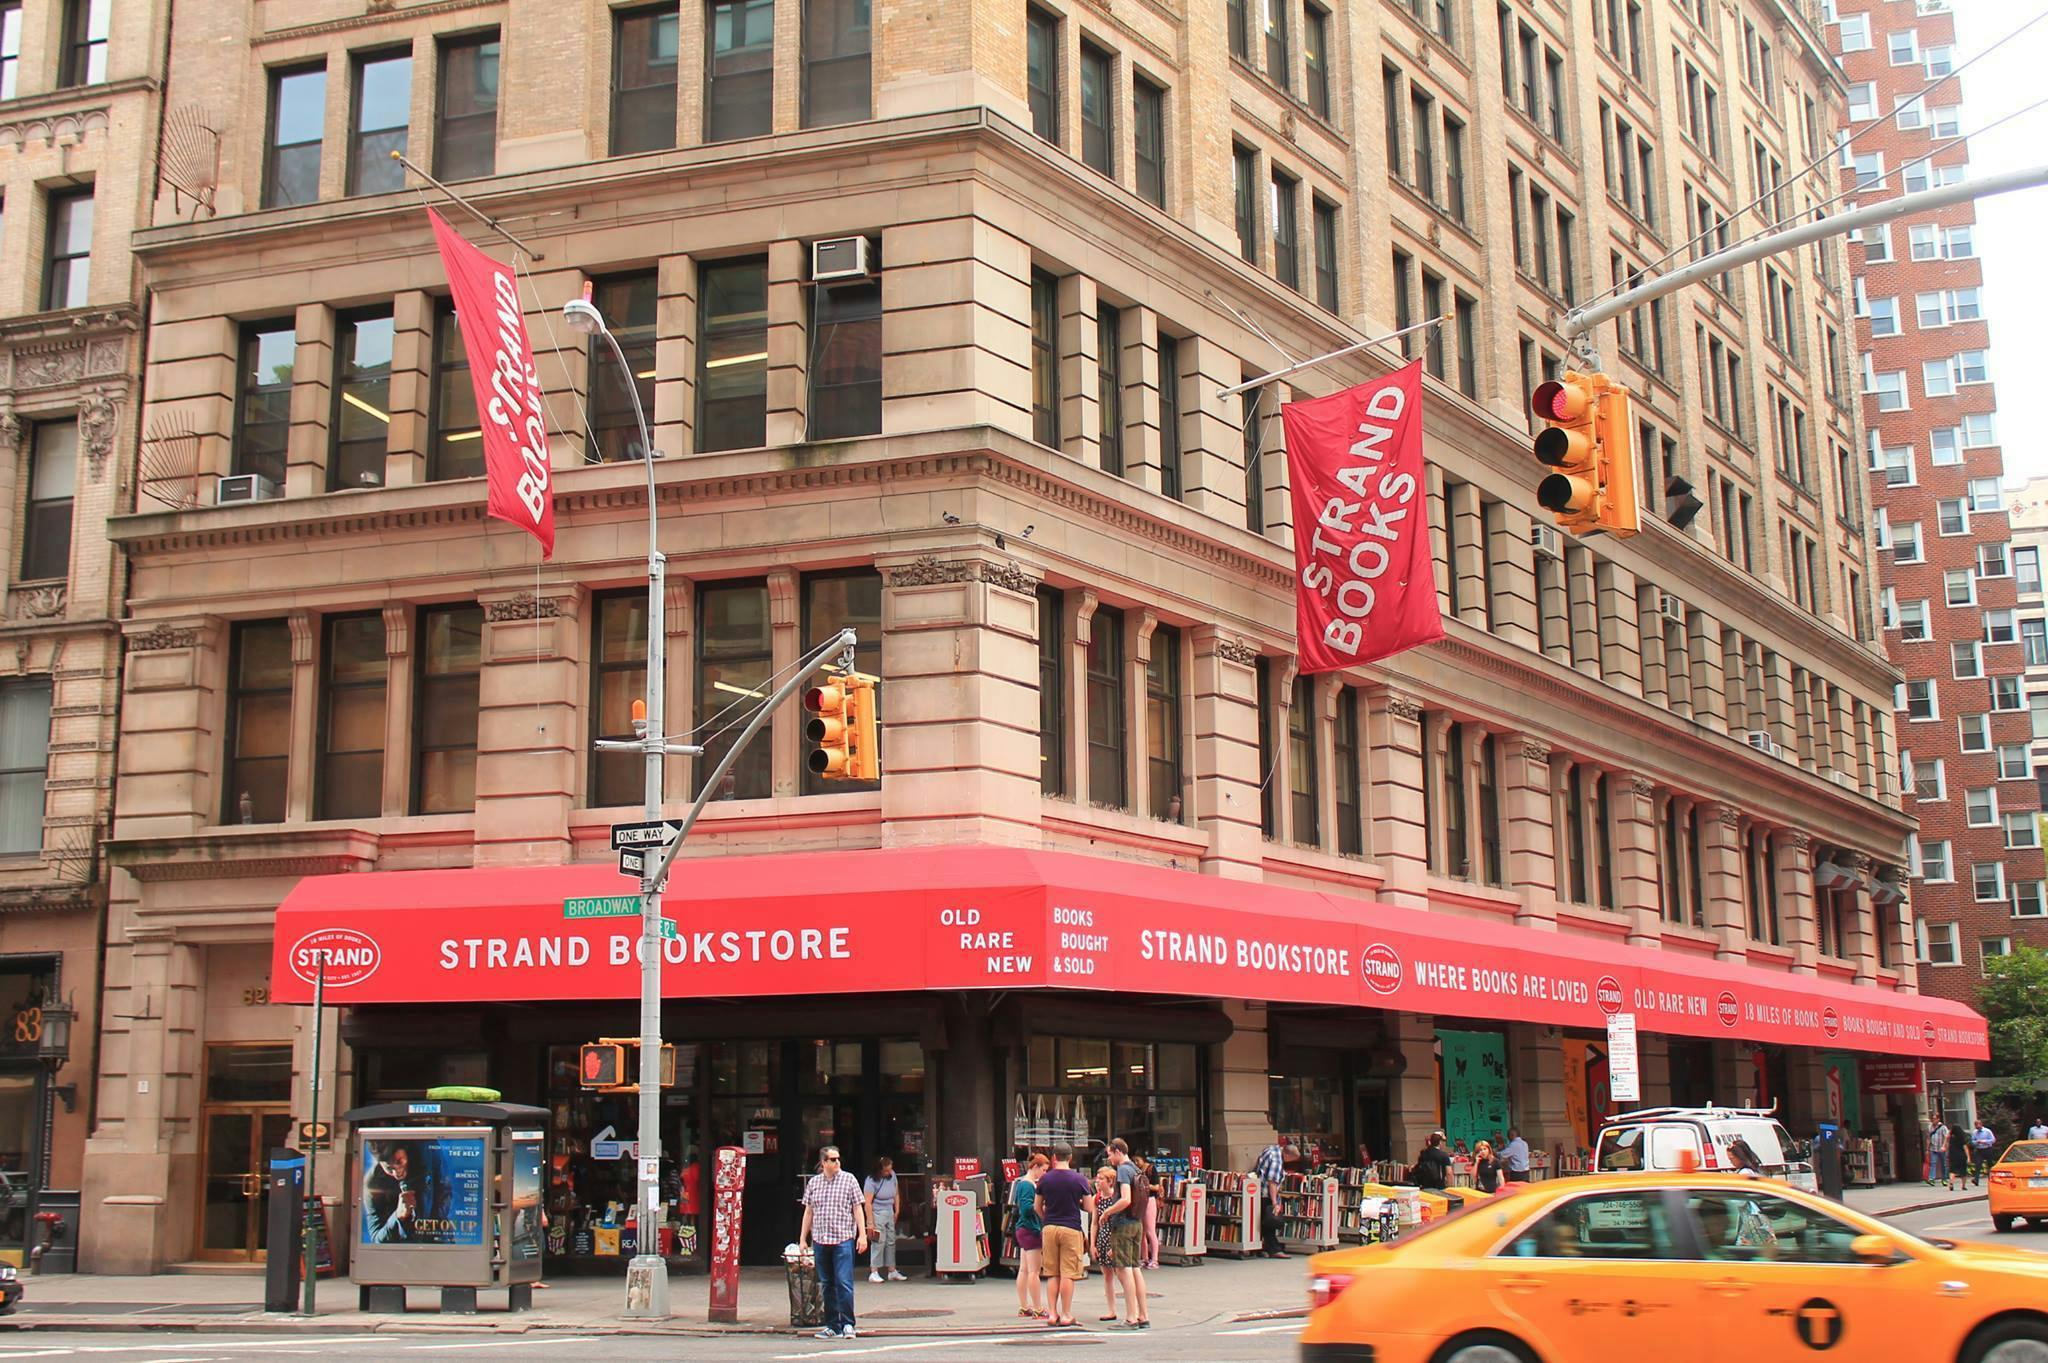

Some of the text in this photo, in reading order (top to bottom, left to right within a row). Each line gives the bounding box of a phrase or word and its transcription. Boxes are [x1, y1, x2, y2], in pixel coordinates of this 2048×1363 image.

[488, 270, 524, 443] STRAND
[1302, 386, 1406, 597] STRAND
[1323, 471, 1416, 656] BOOKS
[618, 828, 664, 842] ONE WAY
[624, 856, 639, 868] ONE
[568, 898, 635, 916] BROADWAY
[940, 908, 981, 926] OLD
[1053, 907, 1094, 927] BOOKS
[960, 932, 1014, 949] RARE
[1061, 932, 1109, 952] BOUGHT
[297, 947, 374, 967] STRAND
[439, 936, 591, 969] STRAND
[1140, 929, 1350, 976] STRAND BOOKSTORE
[987, 956, 1032, 973] NEW
[1053, 956, 1094, 975] & SOLD
[1365, 958, 1400, 979] STRAND
[1414, 960, 1588, 1004] WHERE BOOKS ARE LOVED
[1598, 989, 1622, 1004] STRAND
[1634, 988, 1707, 1016] OLD RARE NEW
[1718, 1002, 1738, 1015] STRAND
[1744, 1002, 1819, 1028] 18 MILES OF BOOKS
[1843, 1015, 1921, 1041] BOOKS BOUGHT AND SOLD
[1937, 1028, 1986, 1046] STRAND BOOKSTORE
[413, 1105, 438, 1113] TITAN
[754, 1108, 774, 1118] ATM
[1825, 1130, 1833, 1140] P
[295, 1169, 302, 1184] P
[414, 1219, 477, 1232] GET ON UP
[621, 1240, 638, 1249] REA
